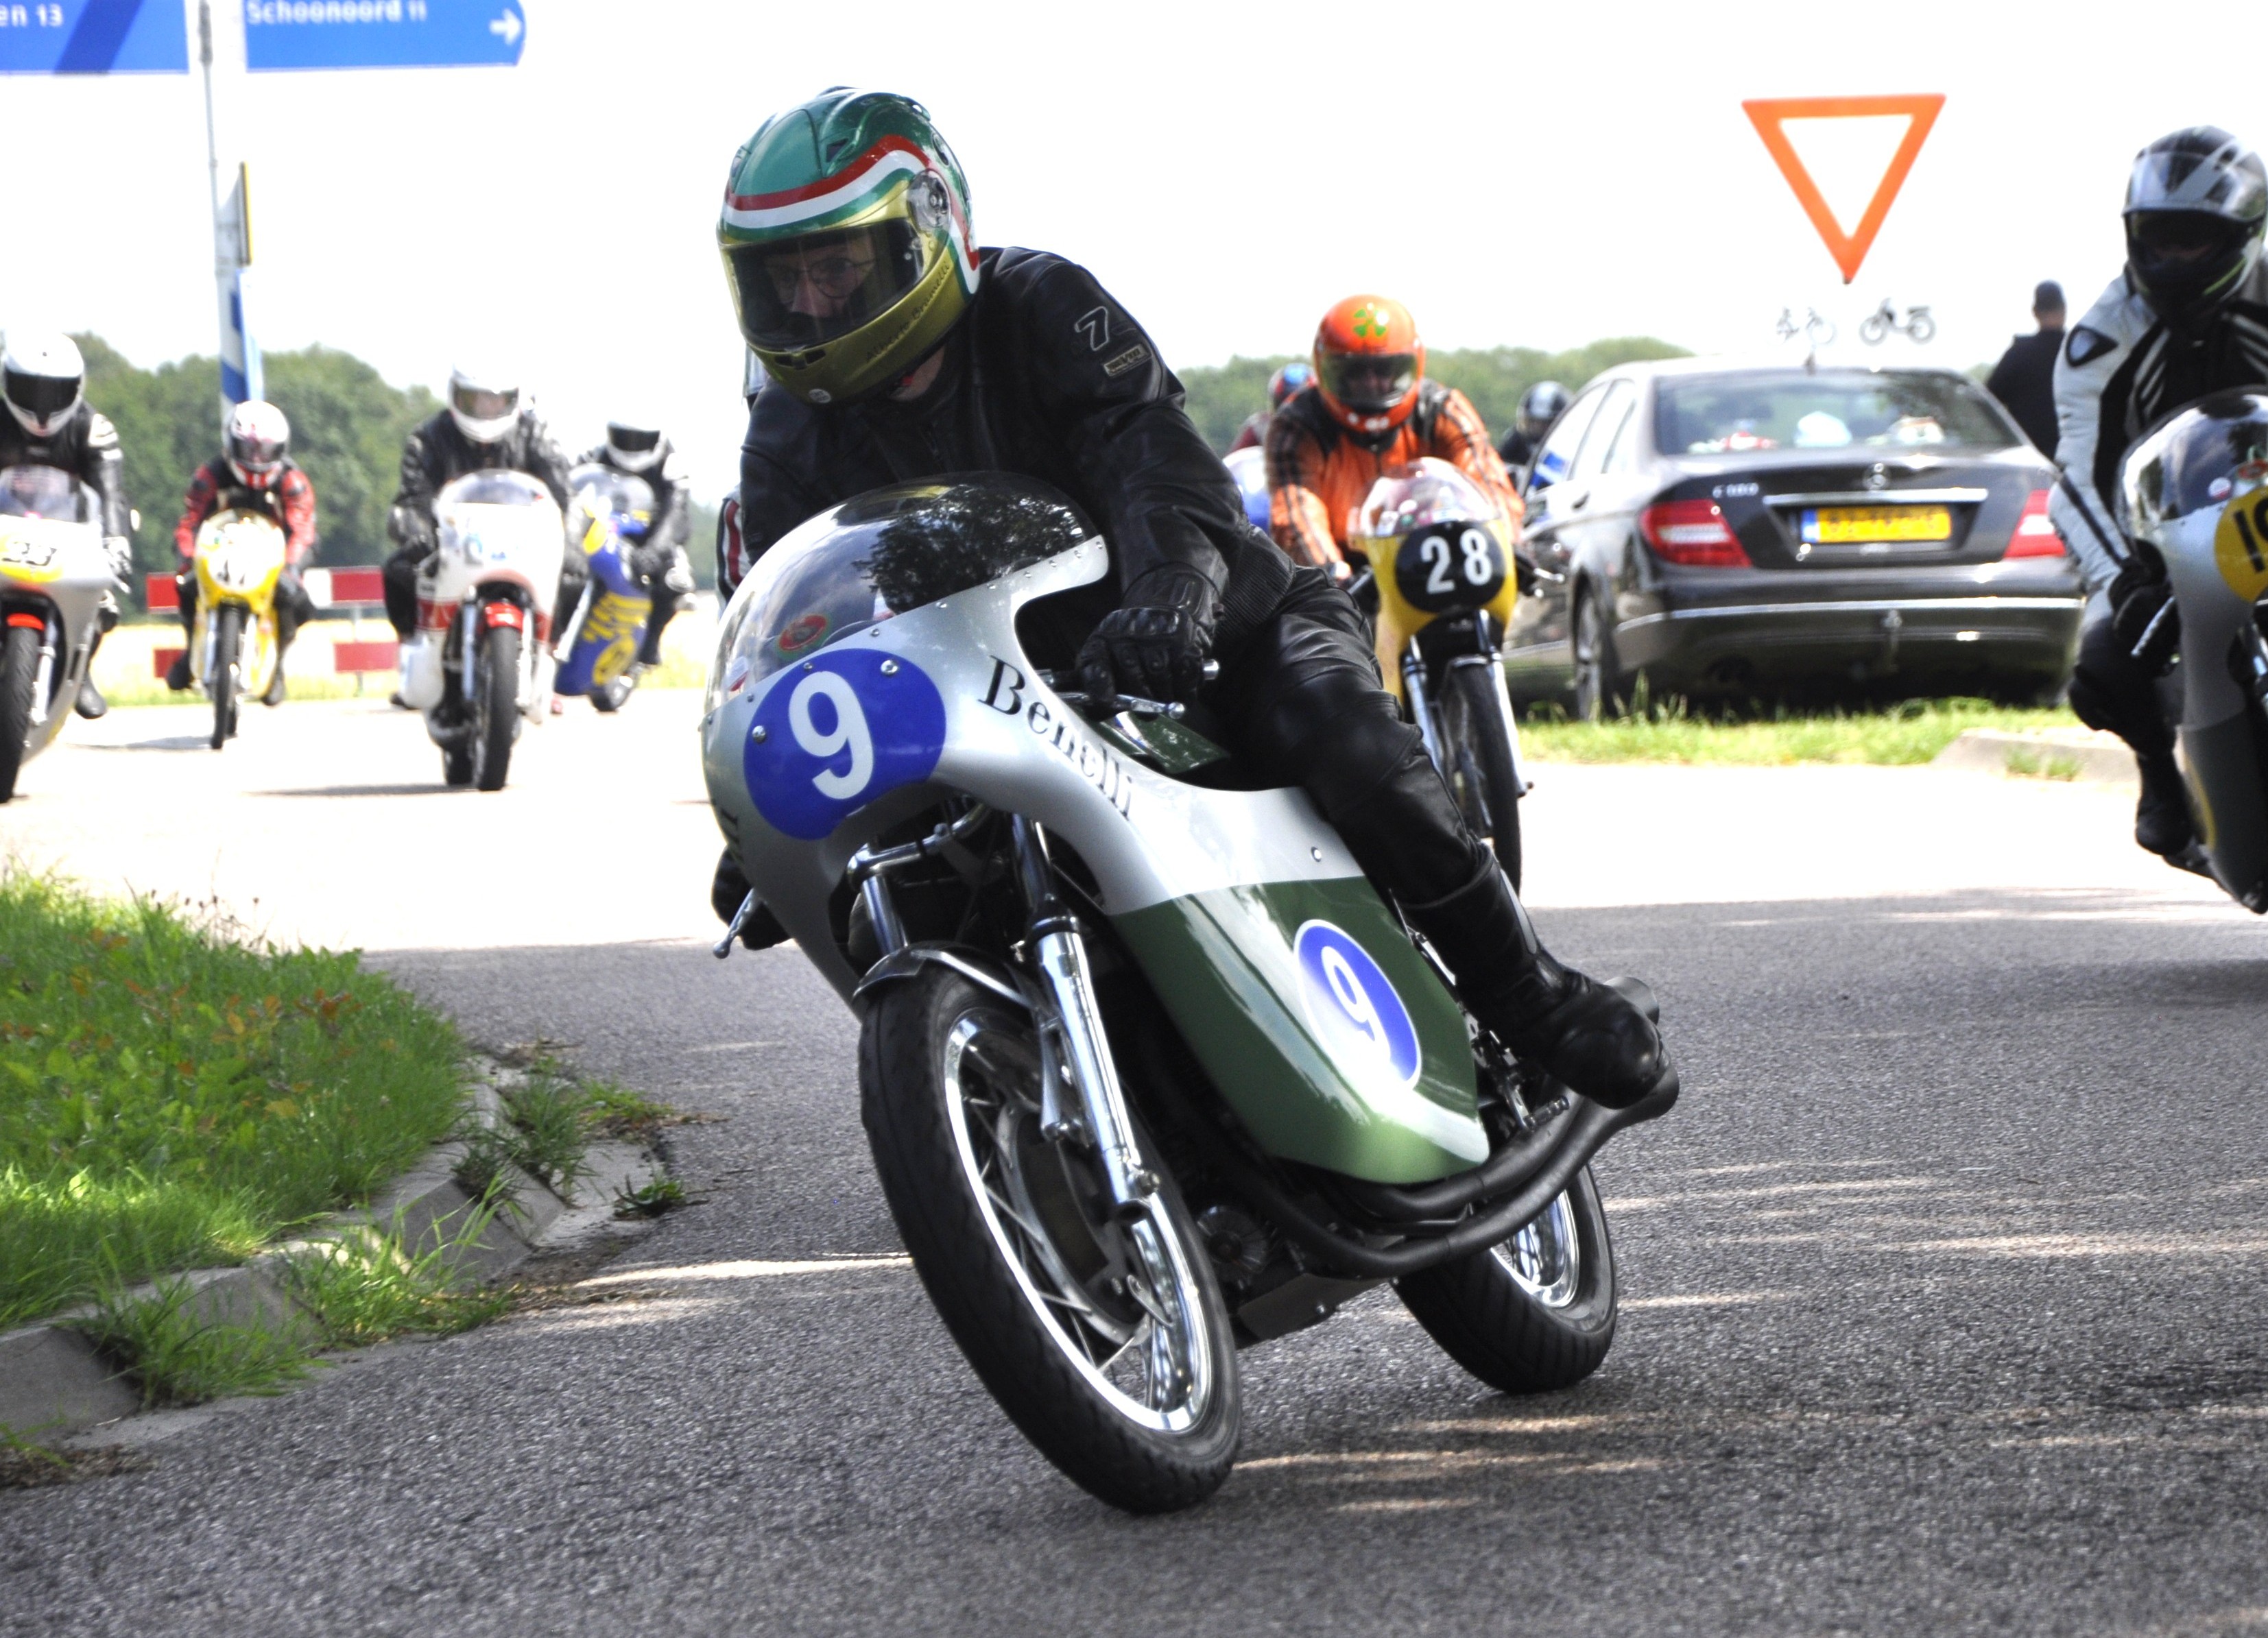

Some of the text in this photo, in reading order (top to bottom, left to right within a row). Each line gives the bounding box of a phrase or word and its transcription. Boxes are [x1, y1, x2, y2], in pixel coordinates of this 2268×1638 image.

[36, 3, 63, 27] 13
[247, 0, 402, 24] Schoonoord
[1074, 306, 1109, 351] 7
[1420, 528, 1492, 594] 28
[789, 671, 873, 799] 9
[978, 654, 1133, 821] Benelli
[1321, 946, 1392, 1076] 9
